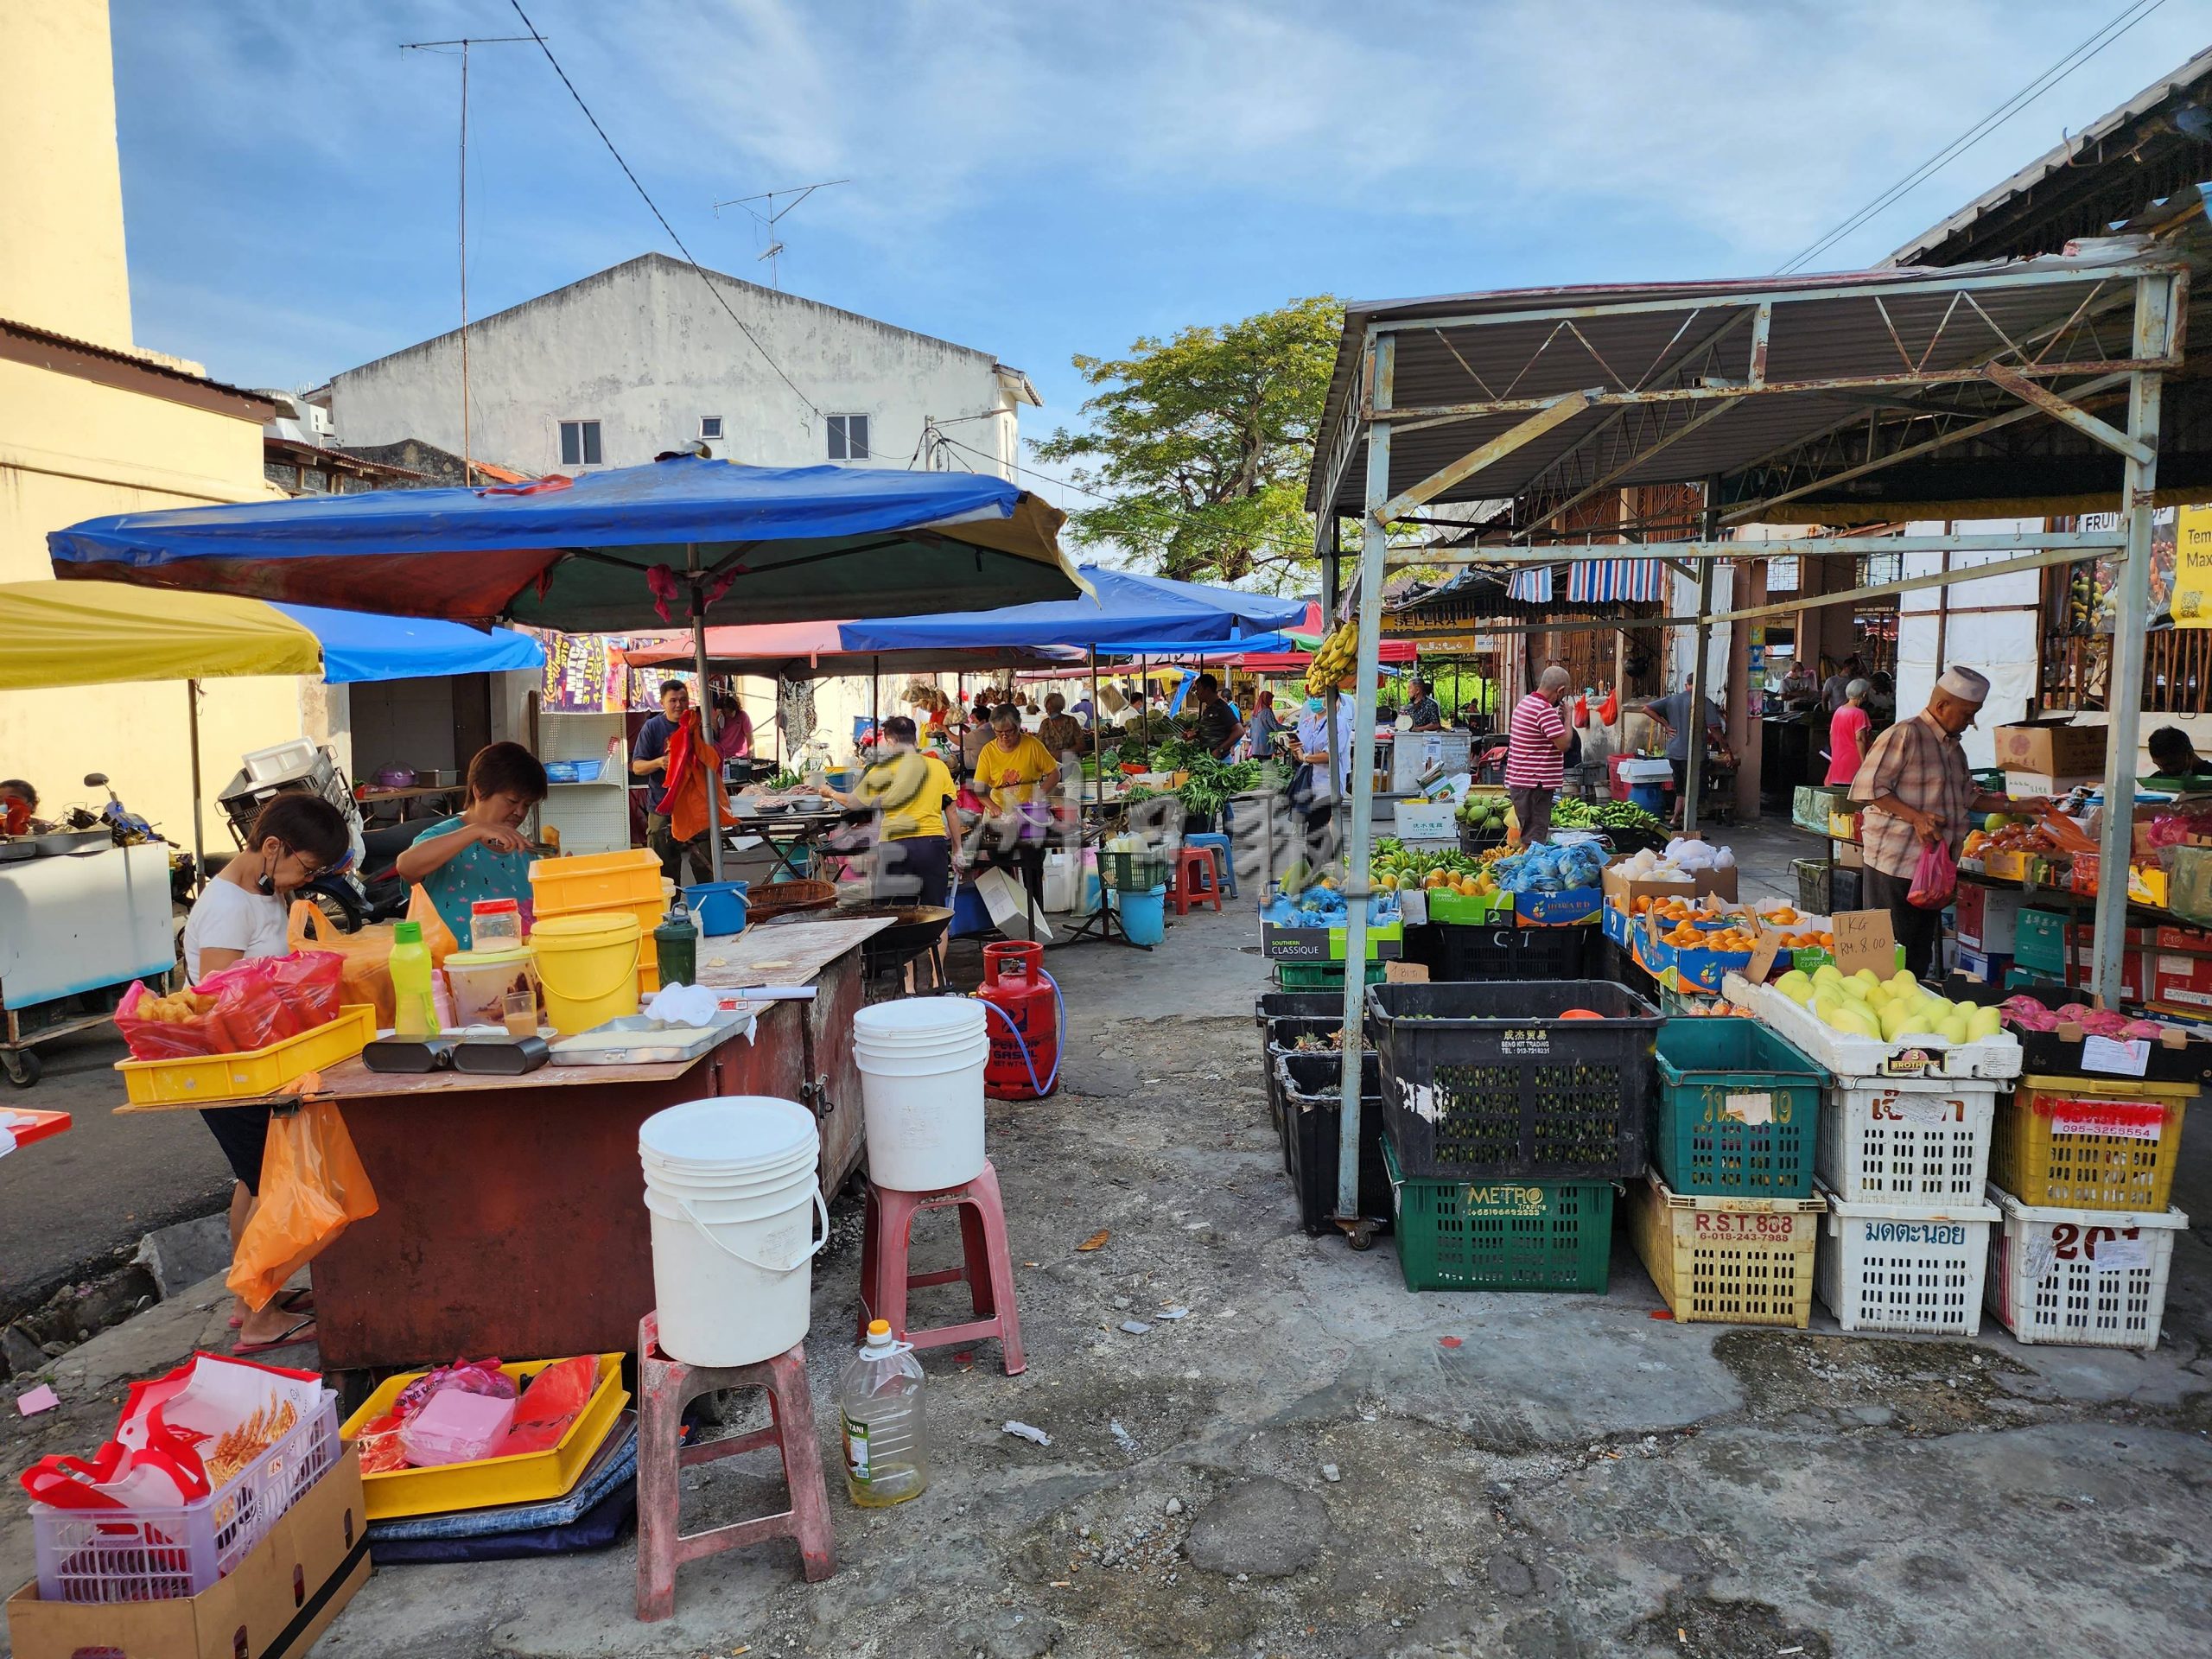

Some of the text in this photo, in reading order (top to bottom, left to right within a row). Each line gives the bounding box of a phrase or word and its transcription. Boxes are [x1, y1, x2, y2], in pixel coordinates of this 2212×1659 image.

[561, 641, 570, 669] 2019
[1272, 945, 1319, 955] CLASSIQUE
[1911, 1051, 1919, 1060] 3
[1468, 1186, 1543, 1205] METRO
[1700, 1232, 1789, 1243] 6-018-243-7988
